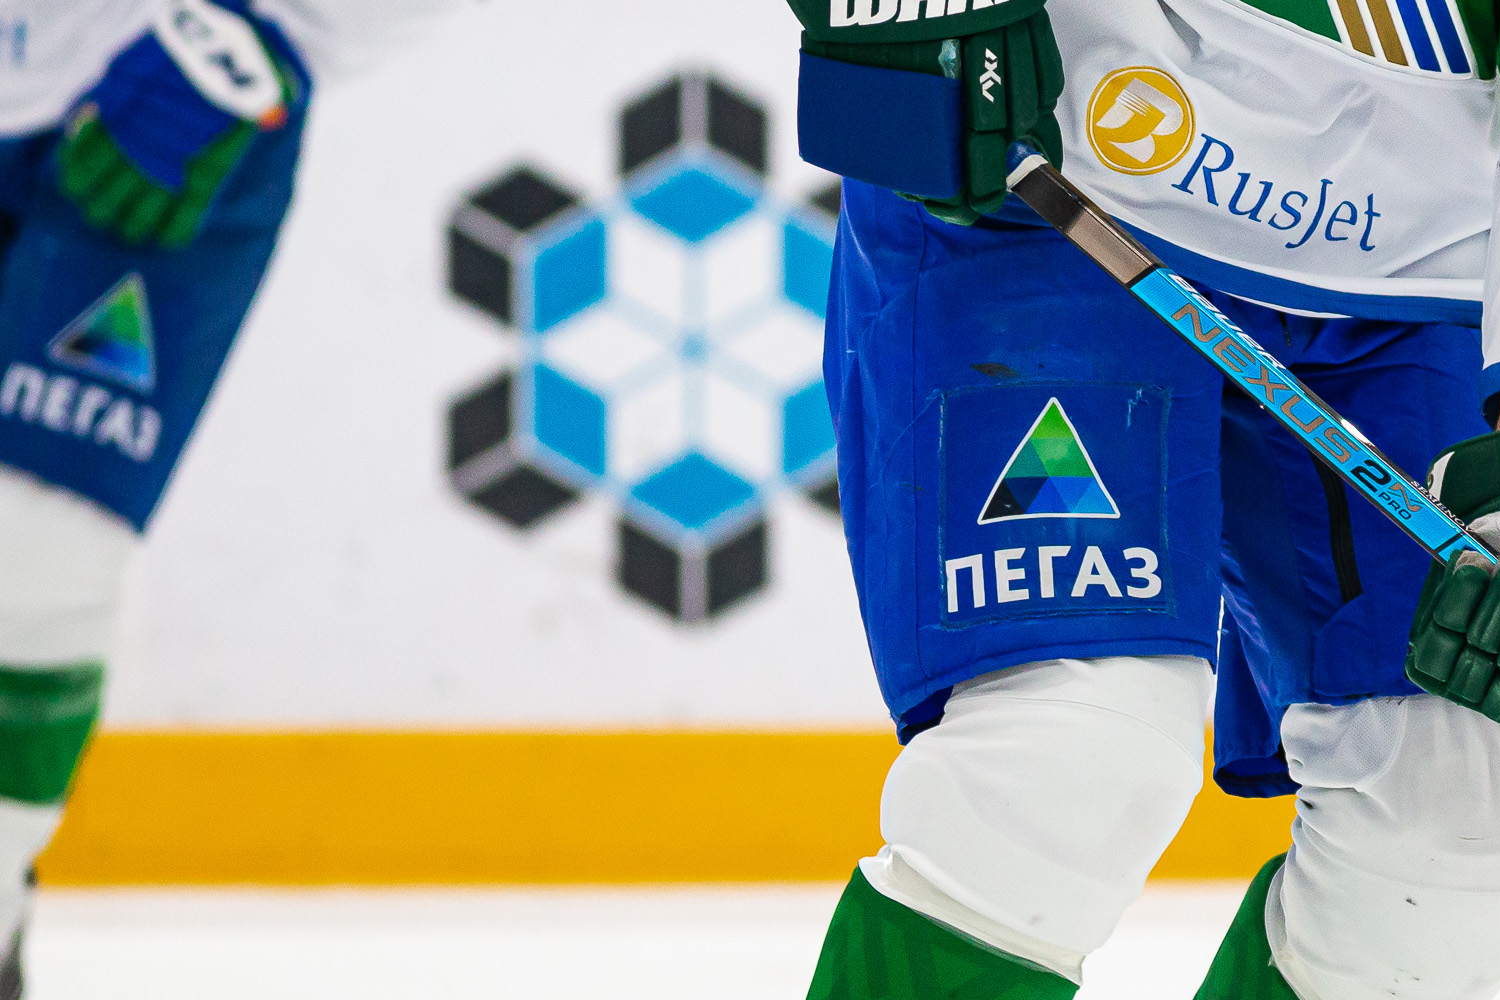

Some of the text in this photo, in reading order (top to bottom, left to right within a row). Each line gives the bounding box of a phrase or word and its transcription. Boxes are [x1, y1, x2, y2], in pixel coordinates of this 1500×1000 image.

[1171, 131, 1383, 253] RusJet
[0, 362, 163, 462] ПЕГАЗ
[1171, 302, 1361, 464] NEXUS
[1378, 491, 1412, 521] PRO
[945, 545, 1163, 613] ПЕГАЗ
